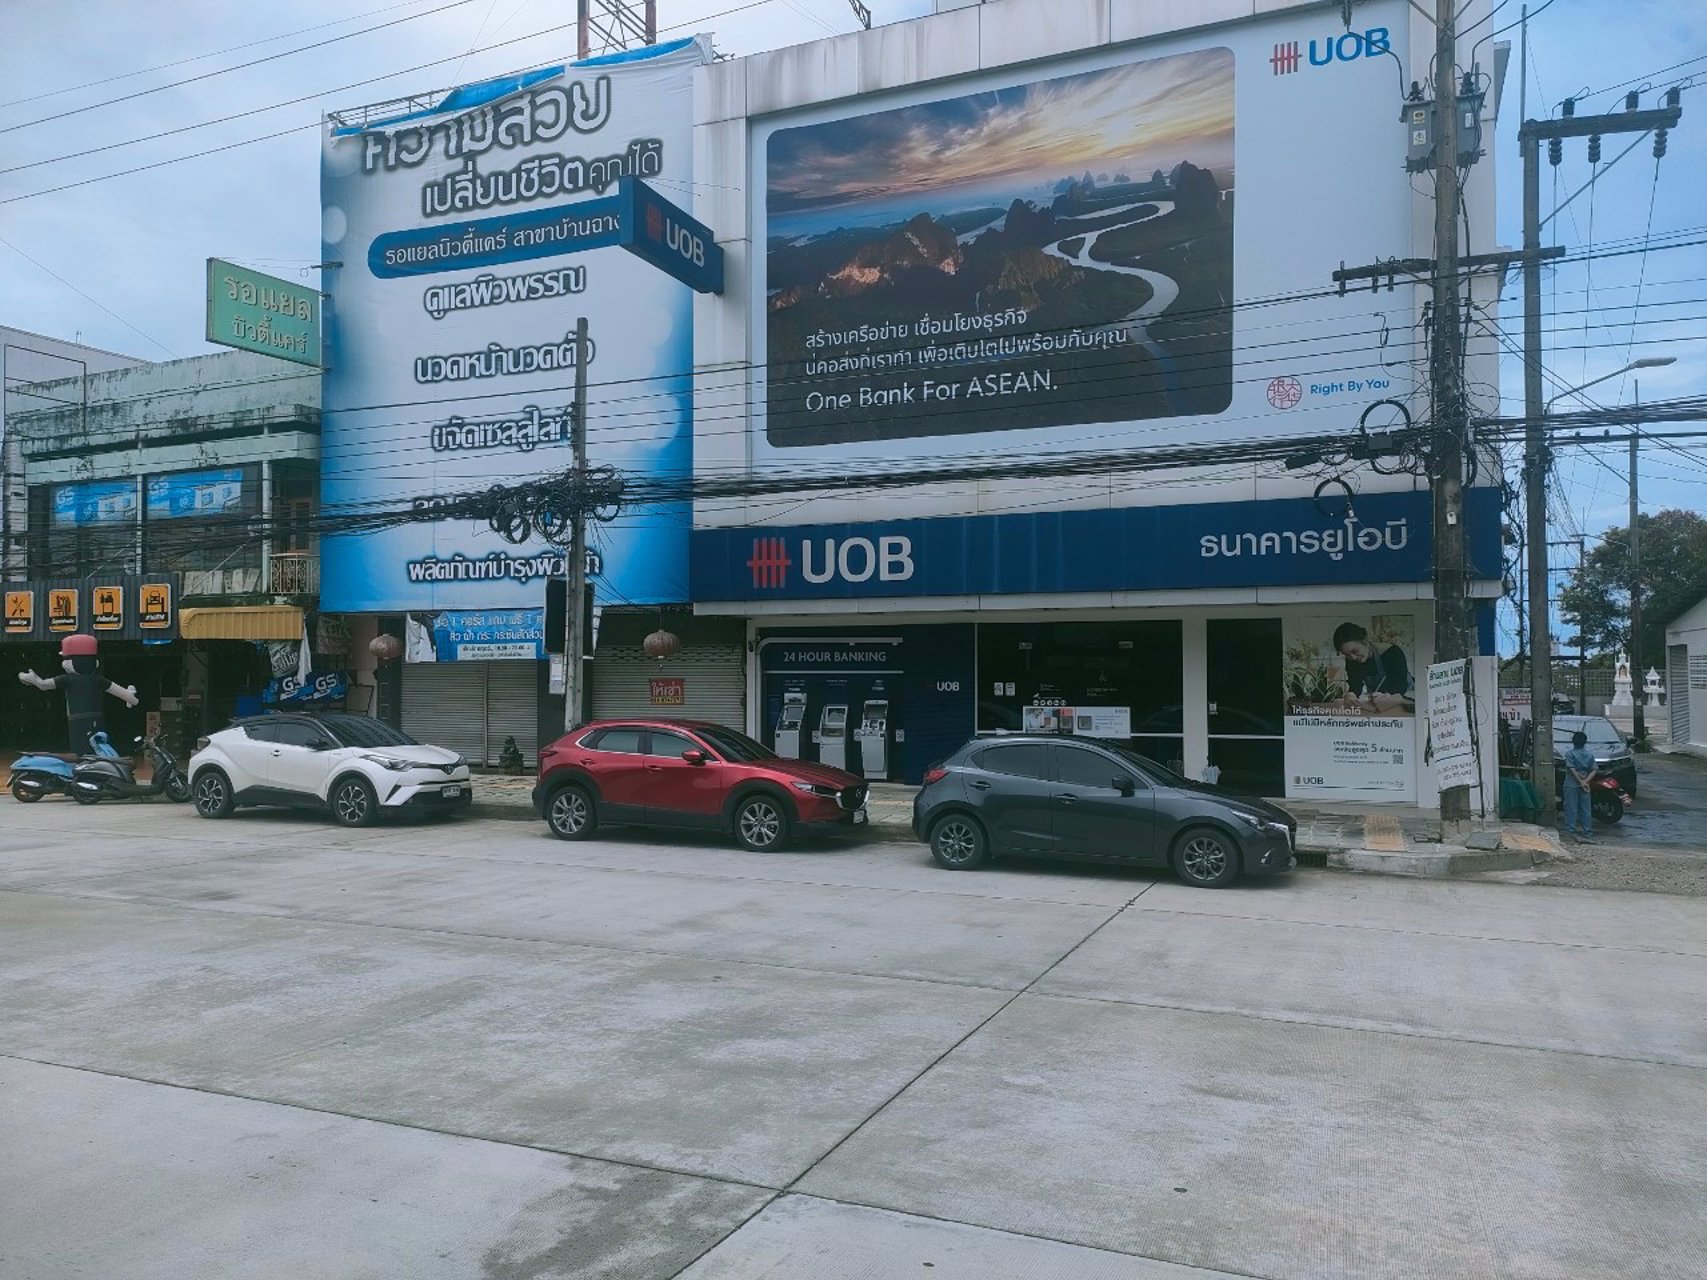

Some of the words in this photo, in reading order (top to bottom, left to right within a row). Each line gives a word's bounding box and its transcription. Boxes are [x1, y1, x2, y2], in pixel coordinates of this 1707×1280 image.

[1309, 27, 1390, 66] UOB
[665, 216, 706, 269] UOB
[425, 267, 585, 319] ดูแลผิวพรรณ
[806, 320, 908, 348] สร้างเครือข่าย
[914, 308, 1027, 336] เชื่อมโยงธุรกิจ
[806, 391, 851, 412] One
[859, 382, 916, 408] Bank
[923, 380, 961, 402] For
[966, 368, 1059, 399] ASEAN.
[1310, 383, 1344, 396] Right
[1347, 380, 1364, 392] By
[1365, 378, 1390, 389] You
[802, 535, 915, 584] UOB
[1200, 517, 1408, 561] ธนาคารยูโอบี
[783, 651, 796, 662] 24
[798, 651, 832, 662] HOUR
[834, 651, 887, 662] BANKING
[937, 681, 960, 692] UOB
